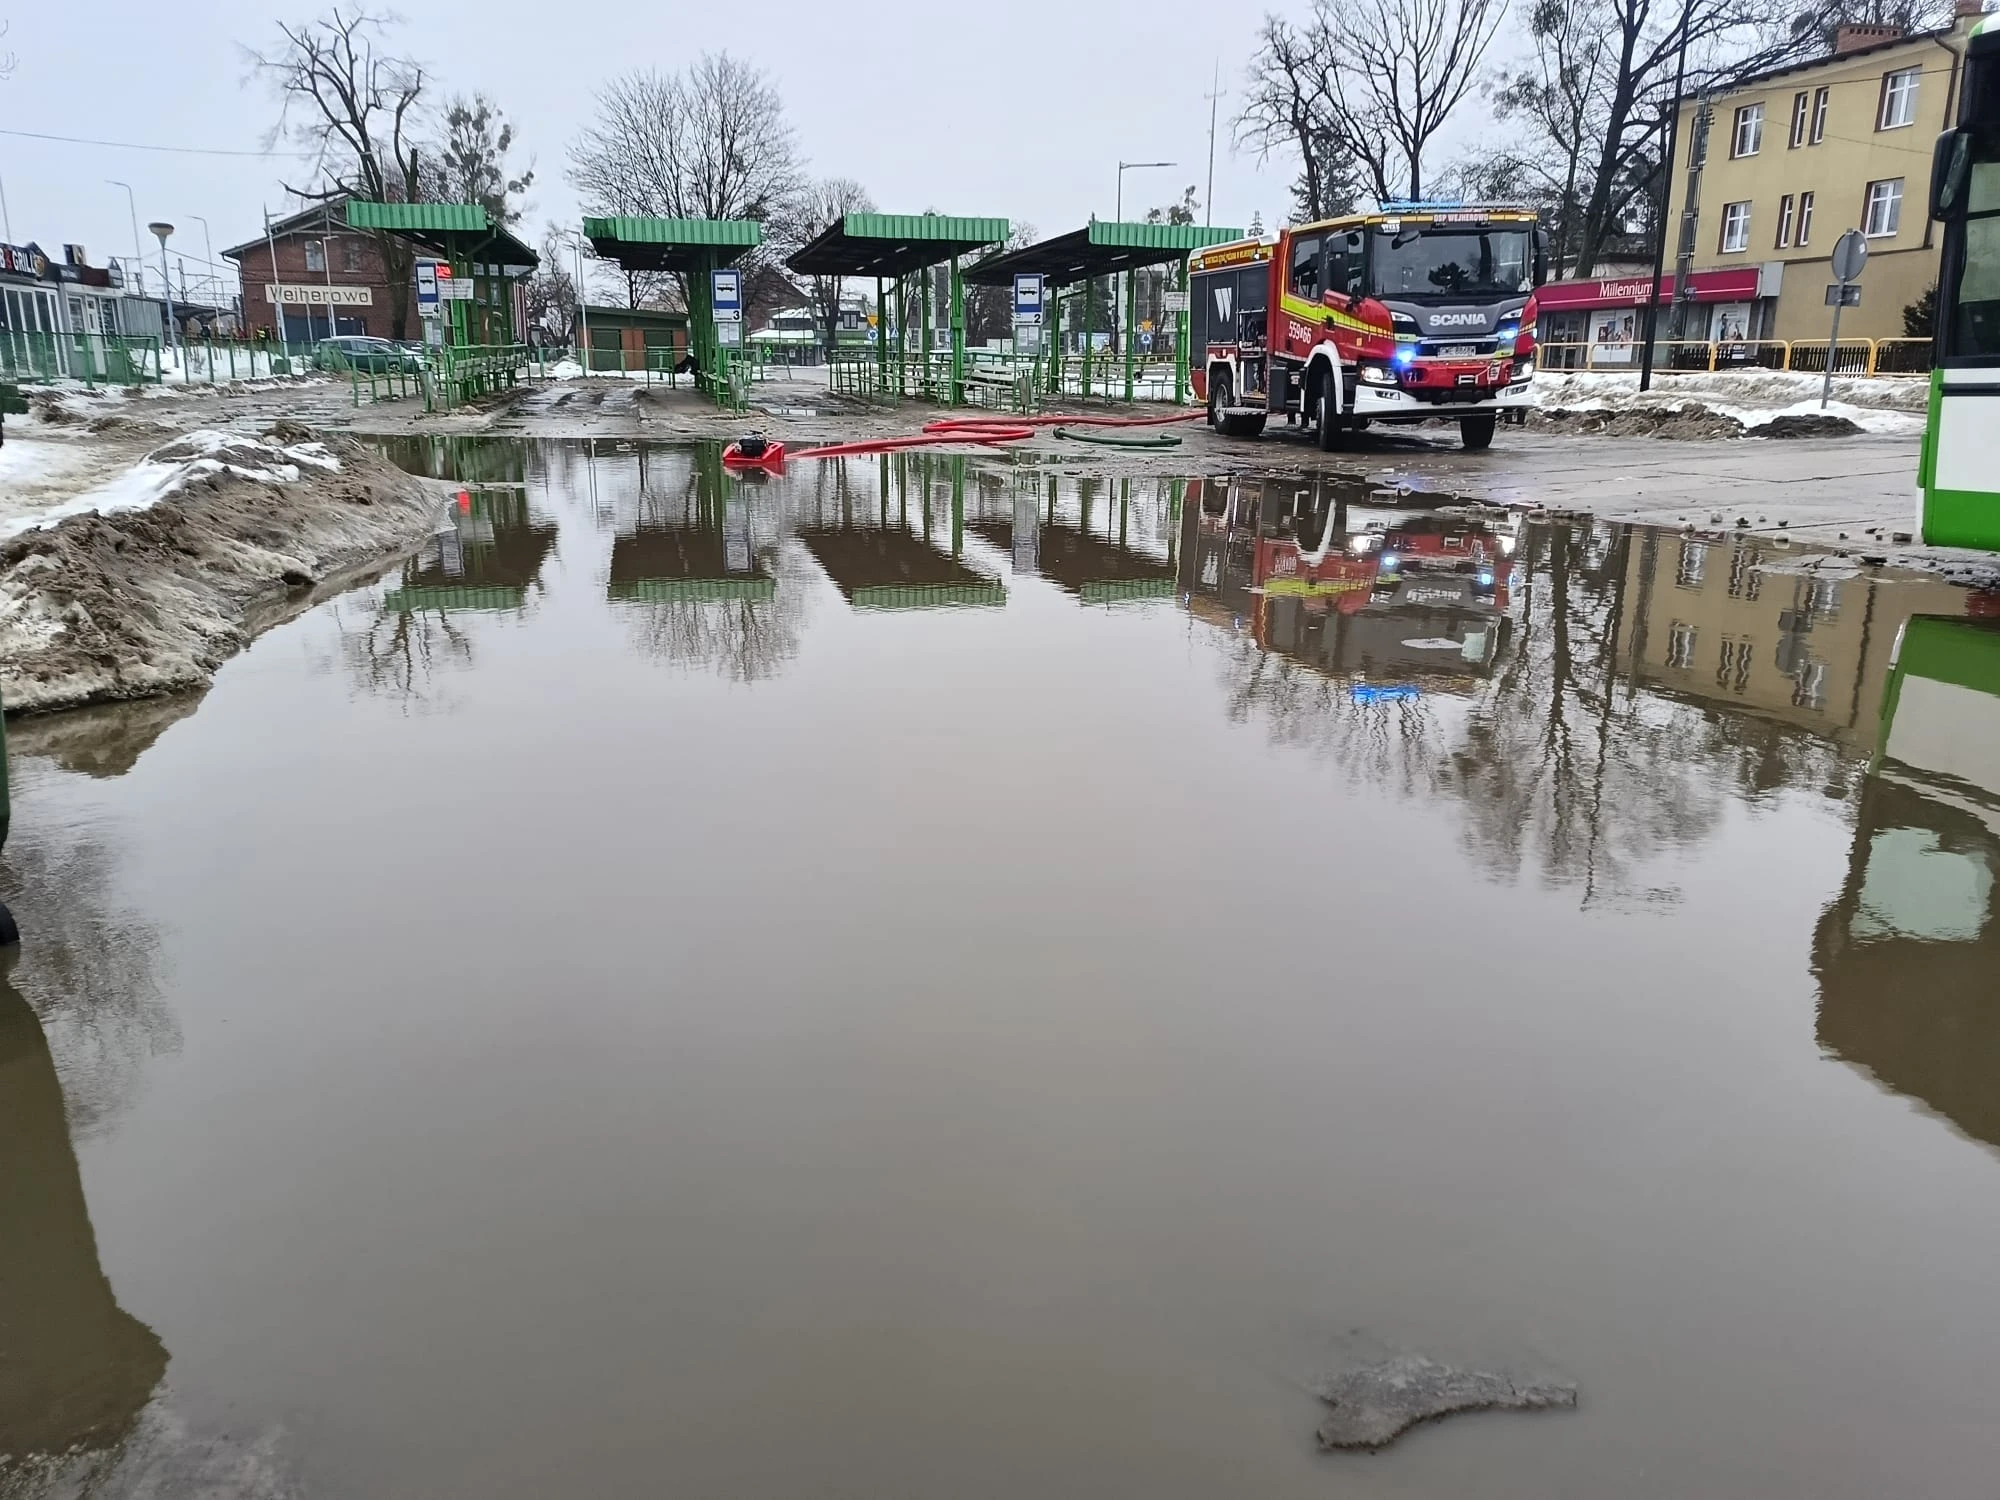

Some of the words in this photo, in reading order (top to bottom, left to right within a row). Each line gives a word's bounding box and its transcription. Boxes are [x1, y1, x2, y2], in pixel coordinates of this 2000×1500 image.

[12, 250, 37, 274] GRILL
[1600, 280, 1653, 297] Millennium
[433, 303, 439, 314] 4
[732, 310, 740, 321] 3
[1034, 313, 1041, 324] 2
[1429, 313, 1487, 327] SCANIA
